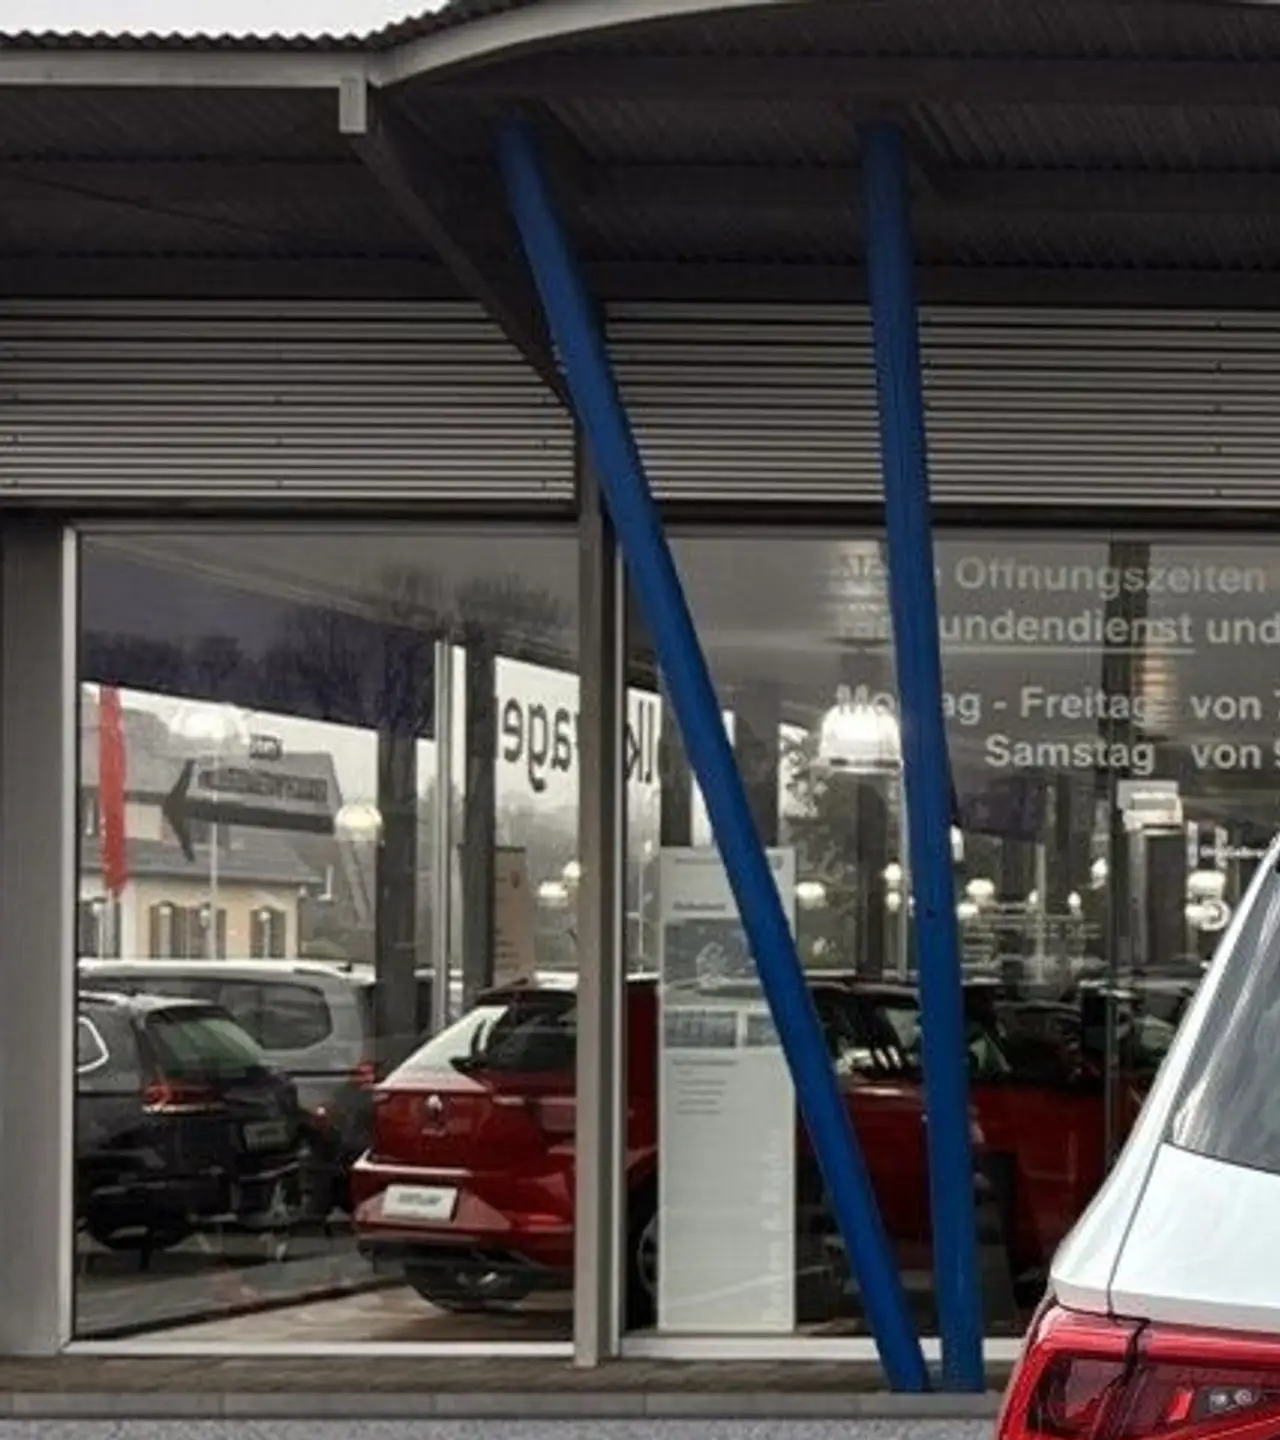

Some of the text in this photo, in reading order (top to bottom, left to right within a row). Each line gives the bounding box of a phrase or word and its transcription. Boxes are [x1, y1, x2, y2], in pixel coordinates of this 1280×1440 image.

[939, 608, 1194, 644] undendienst
[1020, 686, 1155, 727] Freitag
[1190, 695, 1262, 721] von
[984, 734, 1155, 776] Samstag
[1190, 742, 1262, 770] von
